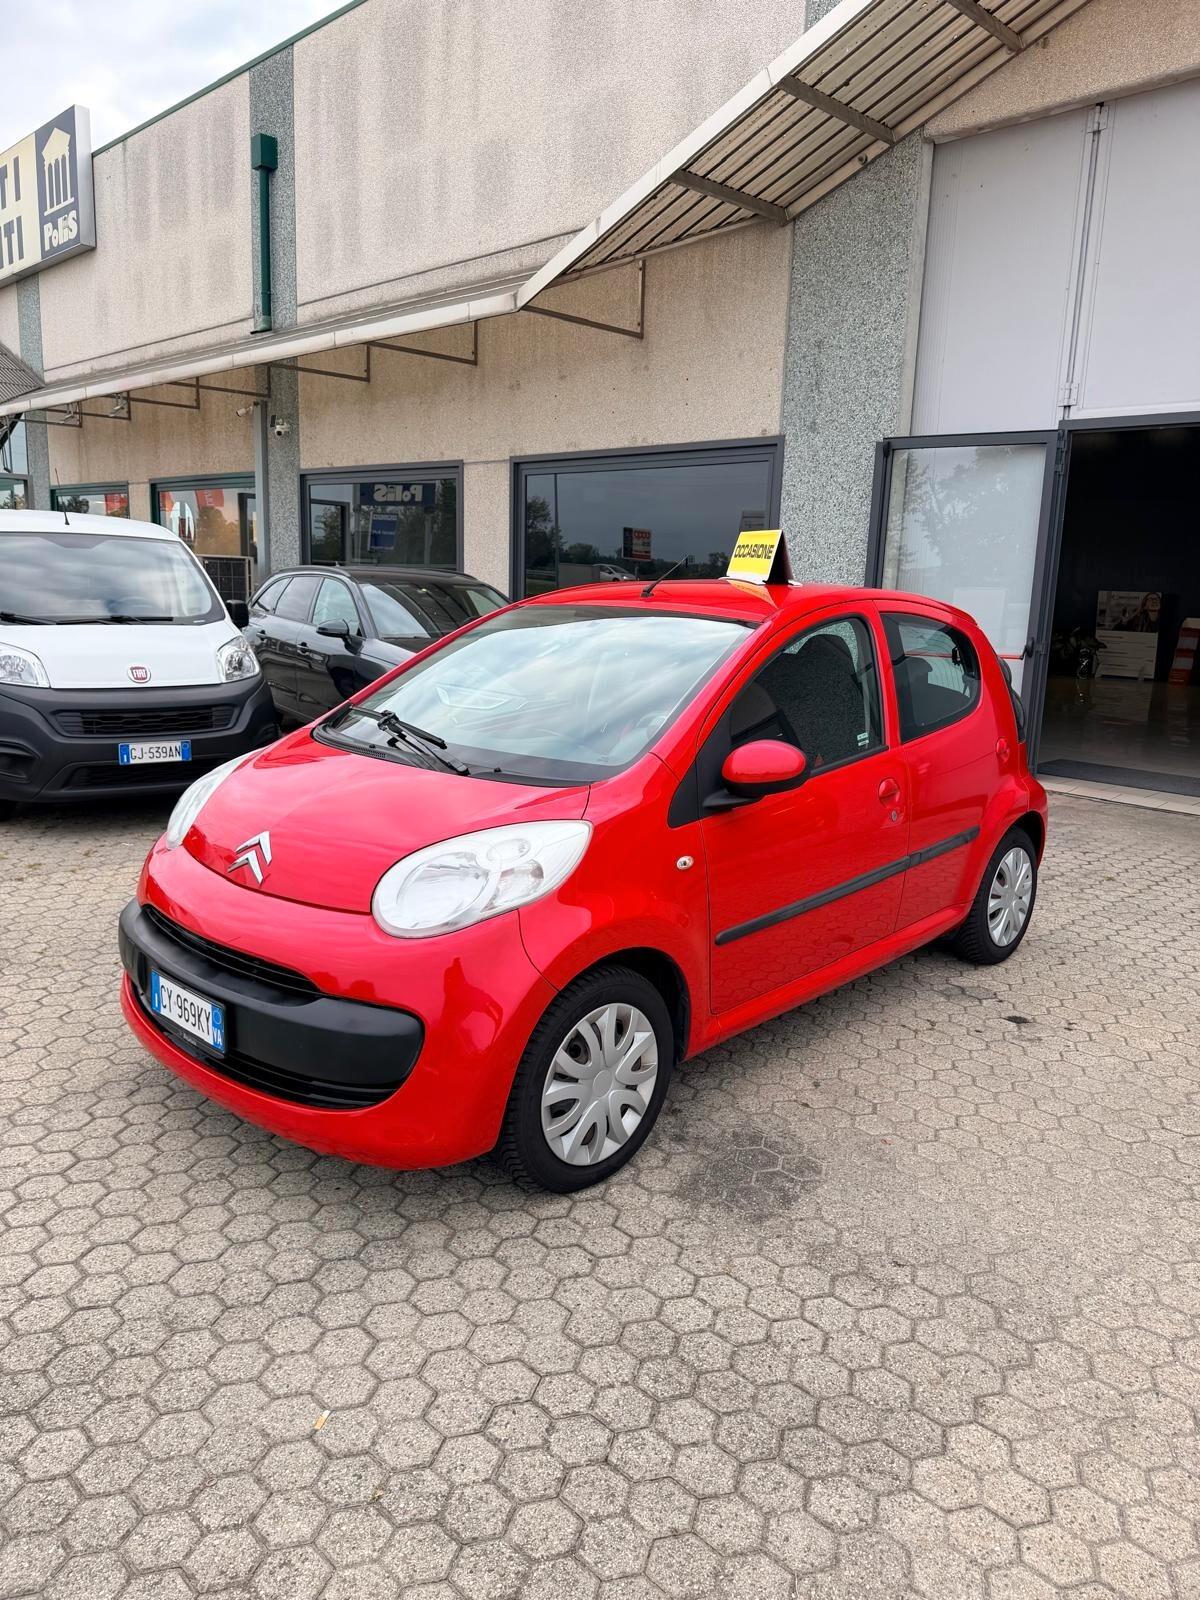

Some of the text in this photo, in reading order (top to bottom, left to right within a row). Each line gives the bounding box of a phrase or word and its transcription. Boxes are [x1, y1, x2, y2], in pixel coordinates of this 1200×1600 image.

[733, 543, 775, 560] OCCASIONE
[160, 985, 172, 1012] CY
[176, 994, 211, 1035] 969KY
